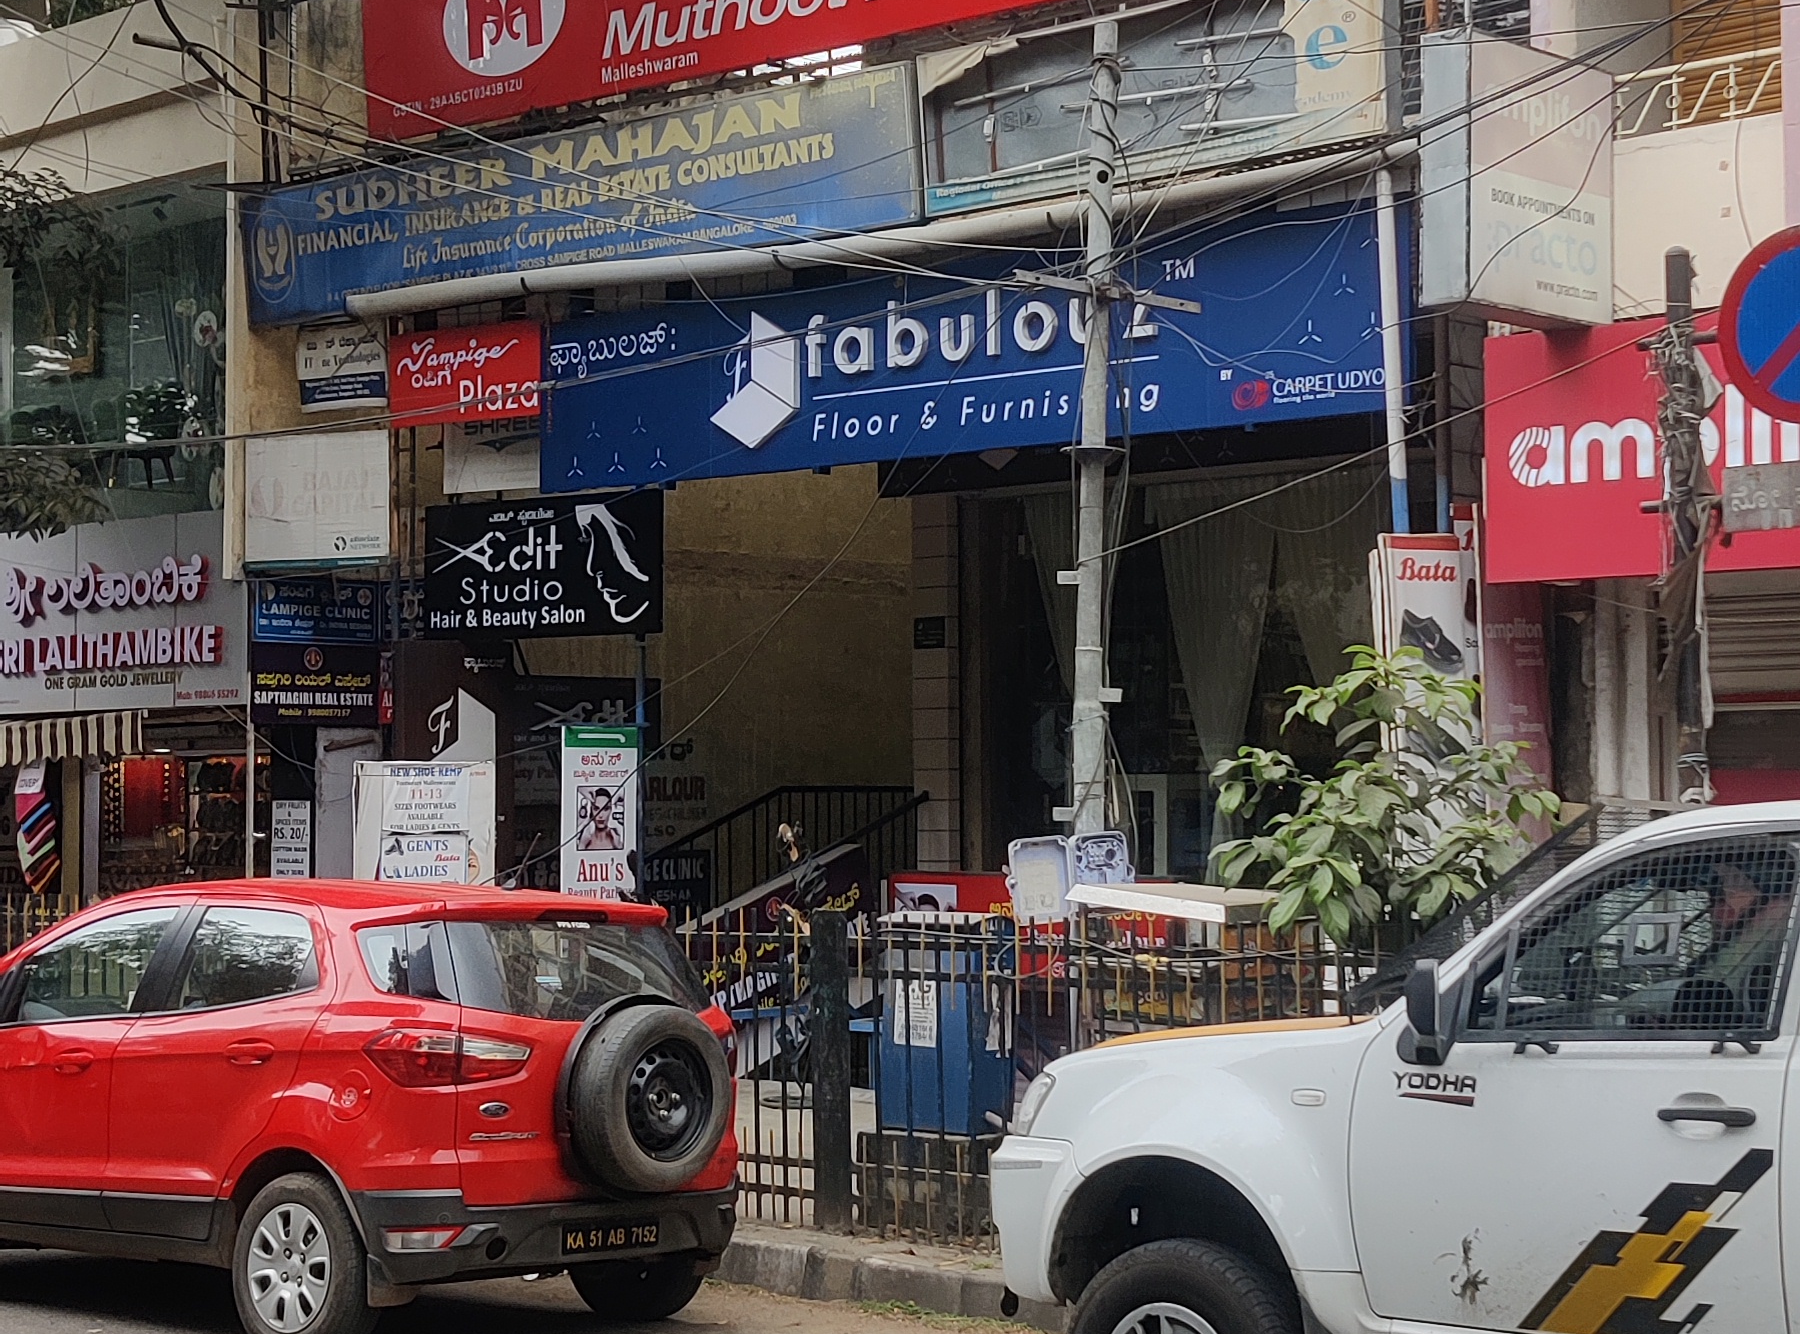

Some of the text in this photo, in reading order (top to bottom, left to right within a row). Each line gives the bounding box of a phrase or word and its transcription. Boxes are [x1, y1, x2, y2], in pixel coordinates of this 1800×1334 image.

[601, 50, 699, 85] Malleshwaram
[314, 92, 802, 222] SUDHEER MAHAJAN
[297, 220, 399, 257] FINANCIAL,
[405, 197, 512, 237] INSURANCE
[541, 181, 593, 212] REAL
[598, 164, 671, 204] ESTATE
[677, 132, 835, 186] CONSULTANTS
[1491, 187, 1596, 226] BOOK APPOINTMENTS ON
[403, 243, 428, 273] Life
[432, 234, 512, 262] Insurance
[516, 210, 617, 252] Corporation
[622, 203, 640, 238] of
[589, 246, 616, 260] ROAD
[1162, 257, 1195, 282] TM
[397, 337, 519, 376] Sampige
[1219, 369, 1233, 381] BY
[1272, 367, 1386, 397] CARPET UDYO
[459, 374, 540, 413] Plaza
[813, 383, 1160, 443] Floor & Furnisng
[1397, 556, 1457, 582] Bata
[459, 577, 563, 605] Studio
[325, 606, 371, 619] CLINIC
[430, 604, 586, 630] Hair & Beauty Salon
[35, 625, 216, 672] LALITHAMBIKE
[44, 670, 184, 691] ONE GRAM GOLD JEWELLERY
[254, 691, 313, 706] SAPTHAGIRI
[315, 692, 338, 706] REAL
[340, 692, 373, 707] ESTATE
[390, 767, 412, 777] NEW
[414, 767, 435, 777] SHOE
[439, 767, 463, 777] KEMP
[394, 801, 457, 811] SIZES FOOTWEARS
[410, 788, 442, 800] 11-13
[406, 823, 427, 831] LADIES
[407, 812, 444, 821] AVAILABLE
[274, 827, 308, 842] RS. 20/-
[407, 839, 449, 852] GENTS
[404, 864, 449, 878] LADIES
[576, 857, 624, 883] Anu's
[567, 886, 598, 898] Beauty
[1394, 1071, 1477, 1094] YODHA
[567, 1224, 658, 1250] KA 51 AB 7152
